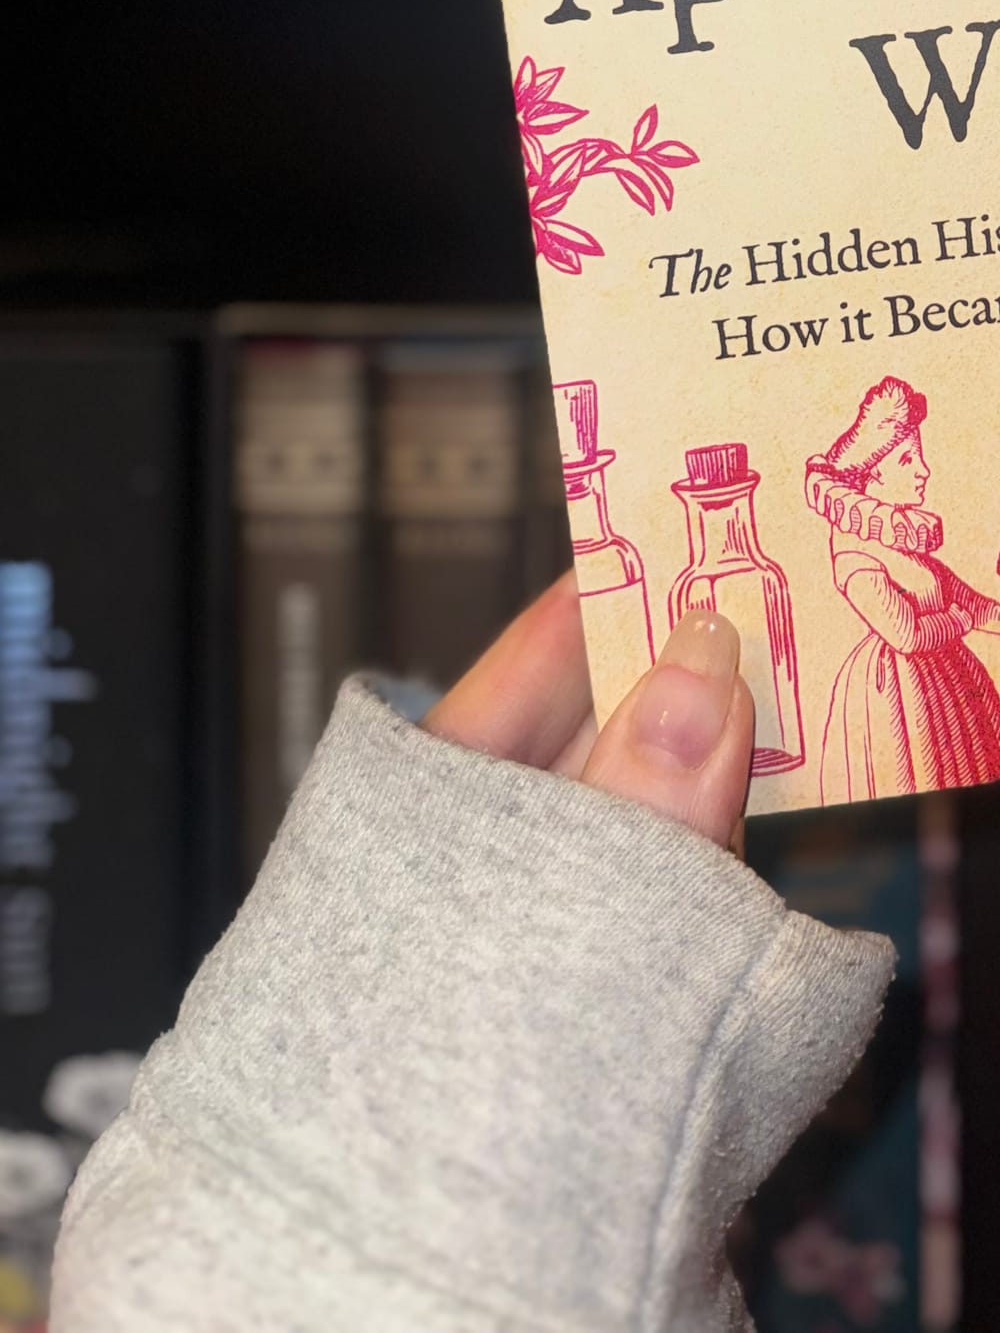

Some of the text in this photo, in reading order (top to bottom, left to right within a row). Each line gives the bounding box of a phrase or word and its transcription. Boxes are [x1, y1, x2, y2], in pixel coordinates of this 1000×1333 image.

[648, 248, 733, 298] The
[743, 231, 922, 286] Hidden
[713, 312, 830, 360] How
[841, 302, 874, 348] it
